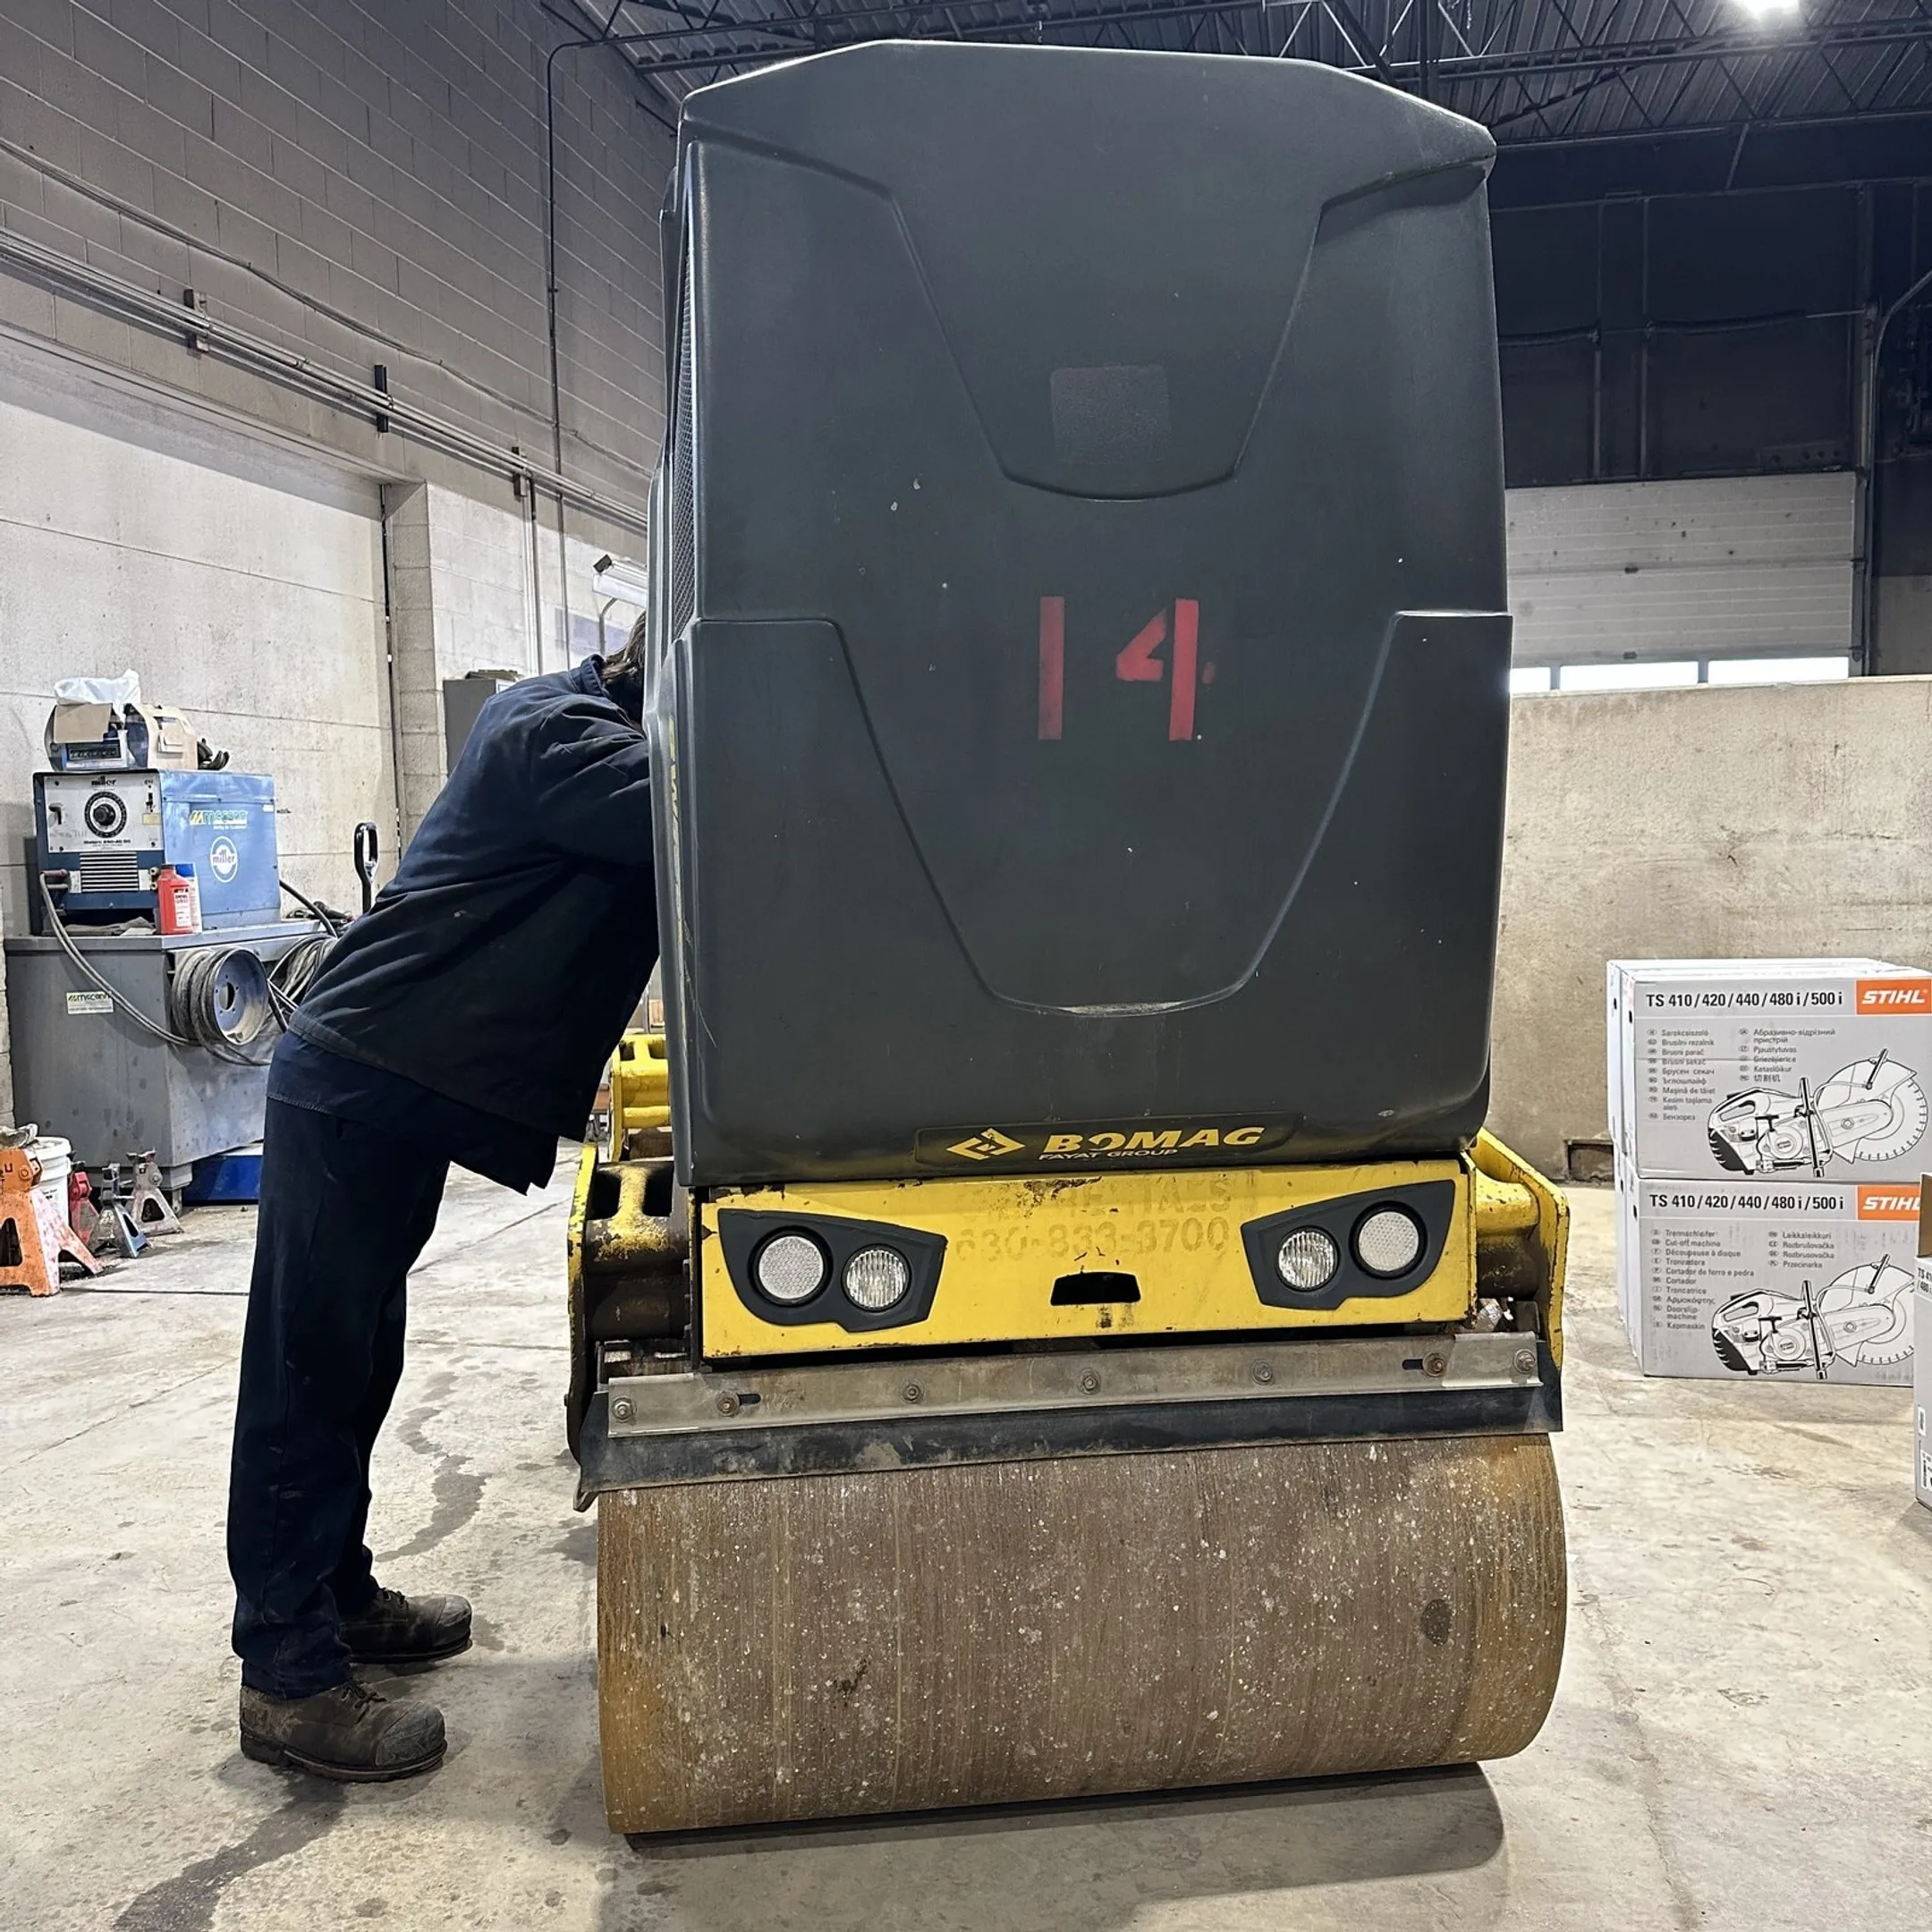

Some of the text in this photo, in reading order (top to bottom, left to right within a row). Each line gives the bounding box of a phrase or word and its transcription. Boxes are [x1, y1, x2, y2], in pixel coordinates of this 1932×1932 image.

[1038, 596, 1199, 741] 14
[212, 850, 235, 863] miller
[1647, 994, 1664, 1007] TS
[1861, 989, 1925, 1004] STIHL
[1043, 1127, 1265, 1153] BOMAG
[1038, 1148, 1178, 1161] FAYAT GROUP
[1649, 1194, 1667, 1208] TS
[1665, 1229, 1716, 1237] Trennschleifer
[1665, 1239, 1690, 1247] Cut-off
[1717, 1250, 1741, 1258] disque
[1733, 1269, 1755, 1277] pedra
[1665, 1286, 1707, 1294] Troncatrice
